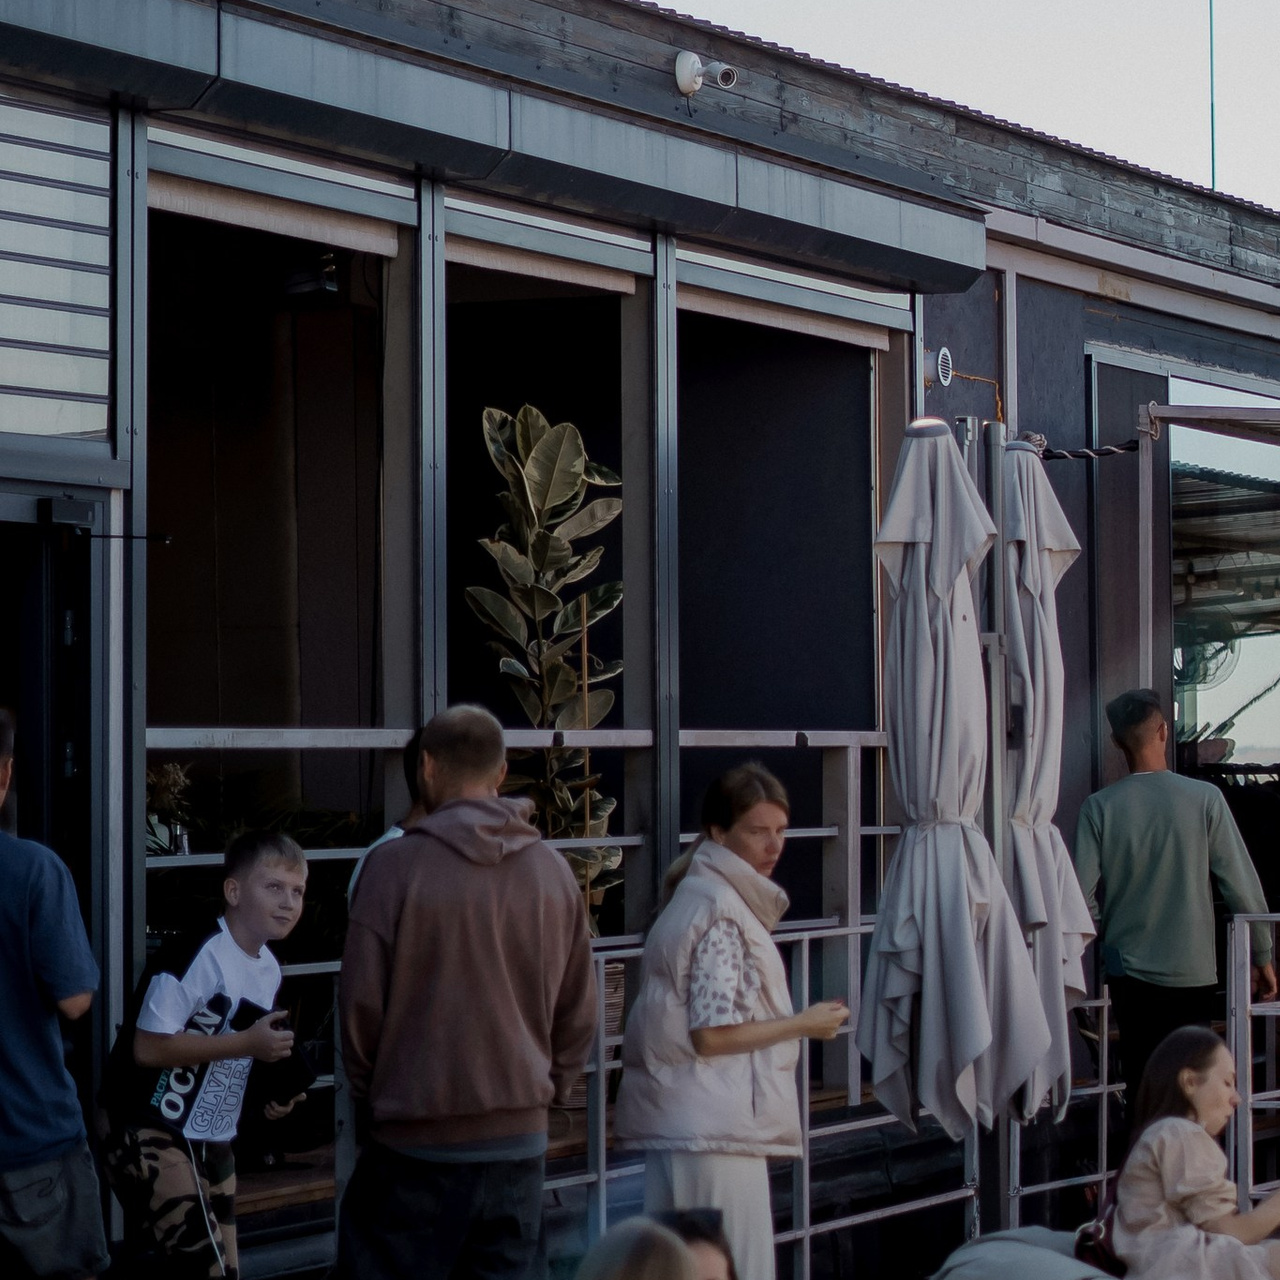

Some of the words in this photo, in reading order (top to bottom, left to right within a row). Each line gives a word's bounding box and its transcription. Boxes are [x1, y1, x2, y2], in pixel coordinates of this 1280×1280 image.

[150, 1068, 171, 1108] PACIFI
[160, 1007, 222, 1120] OCN
[211, 1058, 250, 1136] SUR
